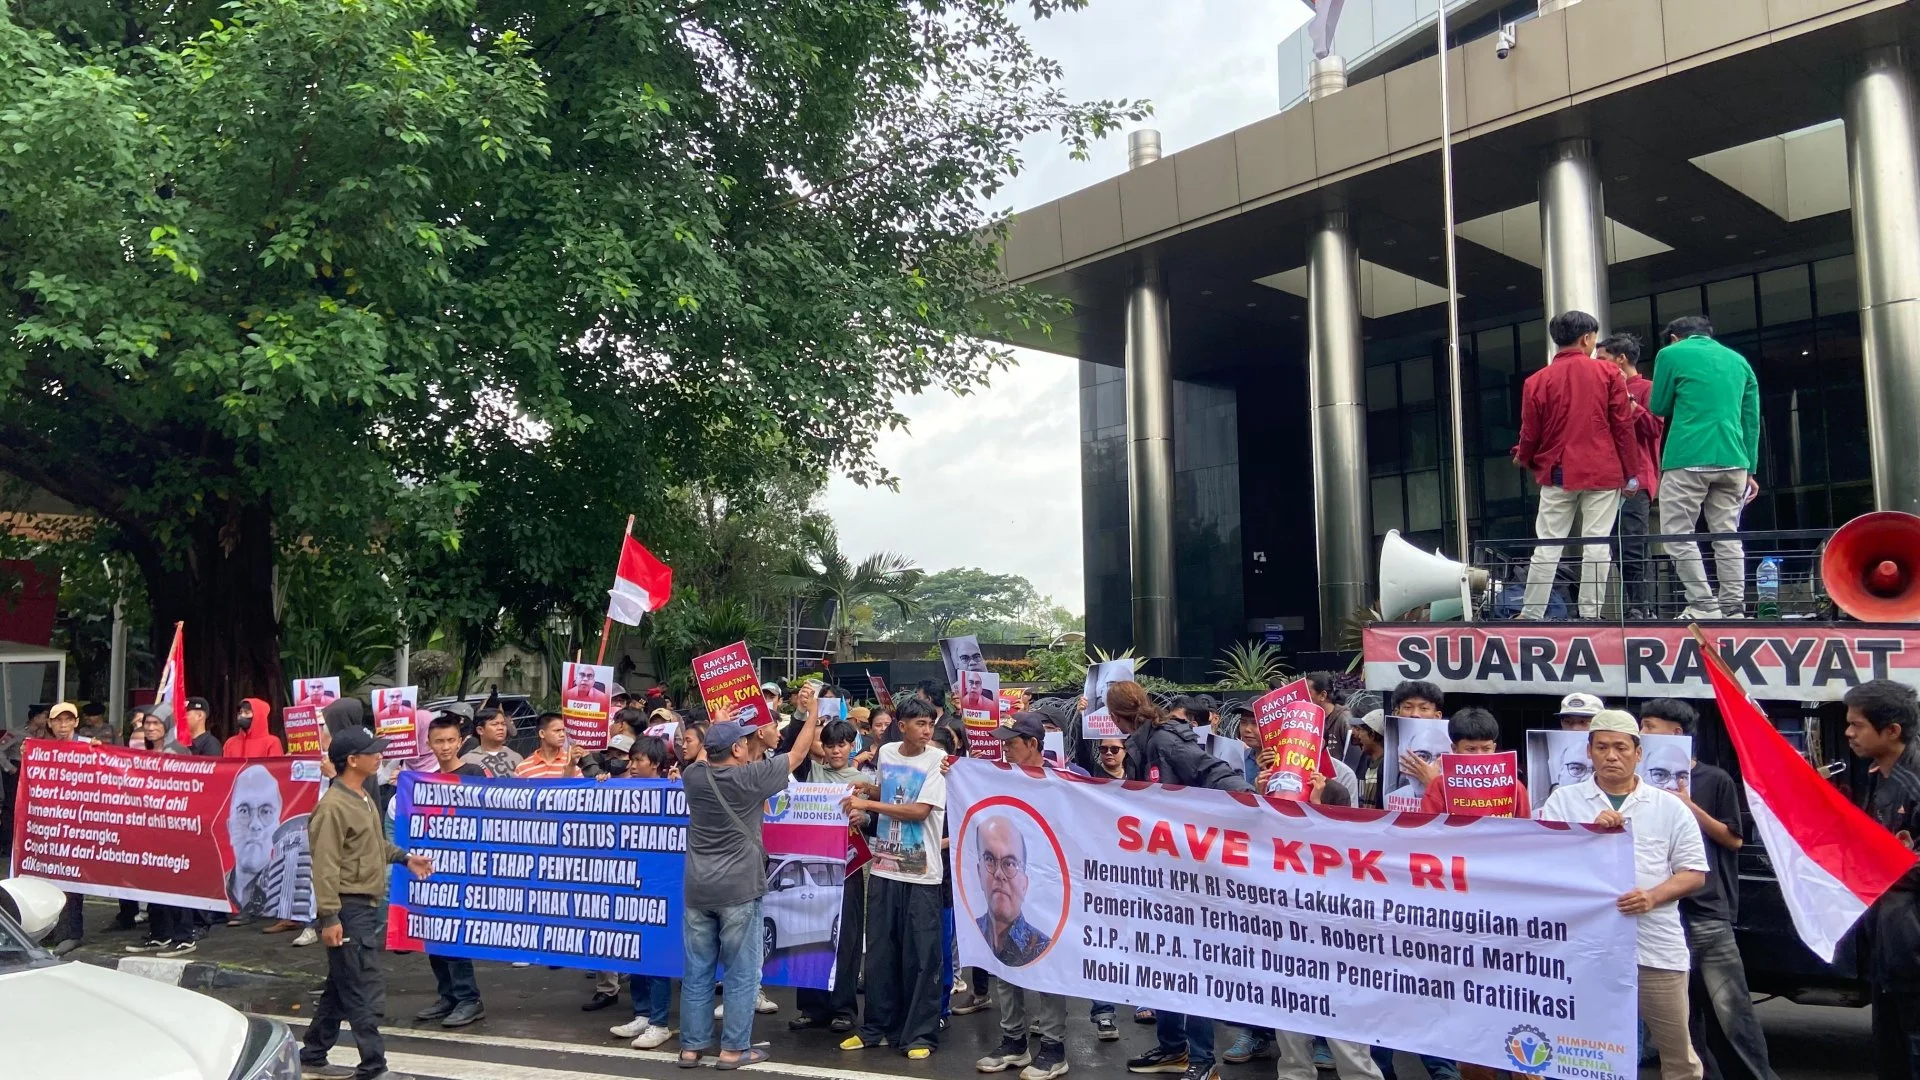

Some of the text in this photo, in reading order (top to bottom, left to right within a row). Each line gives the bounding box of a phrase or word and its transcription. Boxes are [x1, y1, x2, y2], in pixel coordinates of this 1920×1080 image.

[700, 659, 748, 681] SENGSARA
[703, 651, 738, 670] RAKYAT
[1398, 635, 1903, 688] SUARA RAKYAT
[706, 673, 752, 694] PEJABATNYA
[573, 701, 592, 710] COPOT
[1261, 690, 1298, 714] RAKYAT
[566, 718, 598, 728] KEMENKEU
[1285, 709, 1315, 721] KYAT
[577, 730, 607, 738] SARANG
[1282, 720, 1320, 736] GSARA
[971, 739, 999, 747] SARANG
[28, 747, 217, 775] Jika Terdapat Cukup Bukti, Menuntut
[1455, 763, 1506, 775] RAKYAT
[27, 766, 204, 792] KPK RI Segera Tetapkan Saudara Dr
[1447, 775, 1514, 788] SENGSARA
[28, 784, 189, 812] obert Leonard marbun Staf ahli
[413, 782, 483, 807] MENDESAK
[484, 786, 536, 810] KOMISI
[536, 789, 661, 814] PEMBERANTASAN
[793, 794, 828, 803] AKTIVIS
[796, 786, 844, 795] HIMPUNAN
[793, 802, 834, 812] MILENIAL
[1453, 796, 1513, 808] PEJABATNYA
[78, 804, 124, 825] (mantan
[125, 812, 146, 826] staf
[147, 814, 166, 829] ahli
[167, 814, 202, 836] BKPM)
[793, 811, 842, 821] INDONESIA
[62, 825, 121, 846] Tersangka,
[410, 814, 687, 851] RI SEGERA MENAIKKAN STATUS PENANGA
[49, 842, 70, 857] RLM
[71, 844, 95, 860] dari
[95, 847, 140, 865] Jabatan
[141, 851, 190, 873] Strategis
[1116, 815, 1470, 894] SAVE KPK RI
[21, 856, 82, 878] diKemenkeu.
[470, 850, 487, 875] KE
[491, 852, 534, 878] TAHAP
[538, 855, 641, 888] PENYELIDIKAN,
[409, 881, 667, 924] PANGGIL SELURUH PIHAK YANG DIDUGA
[1084, 859, 1568, 942] Menuntut KPK RI Segera Lakukan Pemanggilan dan
[407, 913, 640, 959] TELRIBAT TERMASUK PIHAK TOYOTA
[1083, 891, 1573, 985] Pemeriksaan Terhadap Dr. Robert Leonard Marbun,
[1083, 924, 1576, 1021] S.I.P., M.P.A. Terkait Dugaan Penerimaan Gratifikasi
[1082, 958, 1337, 1017] Mobil Mewah Toyota Alpard.
[1557, 1035, 1625, 1054] HIMPUNAN
[1557, 1045, 1604, 1060] AKTIVIS
[1557, 1055, 1614, 1072] MILENIAL
[1557, 1064, 1625, 1080] INDONESIA
